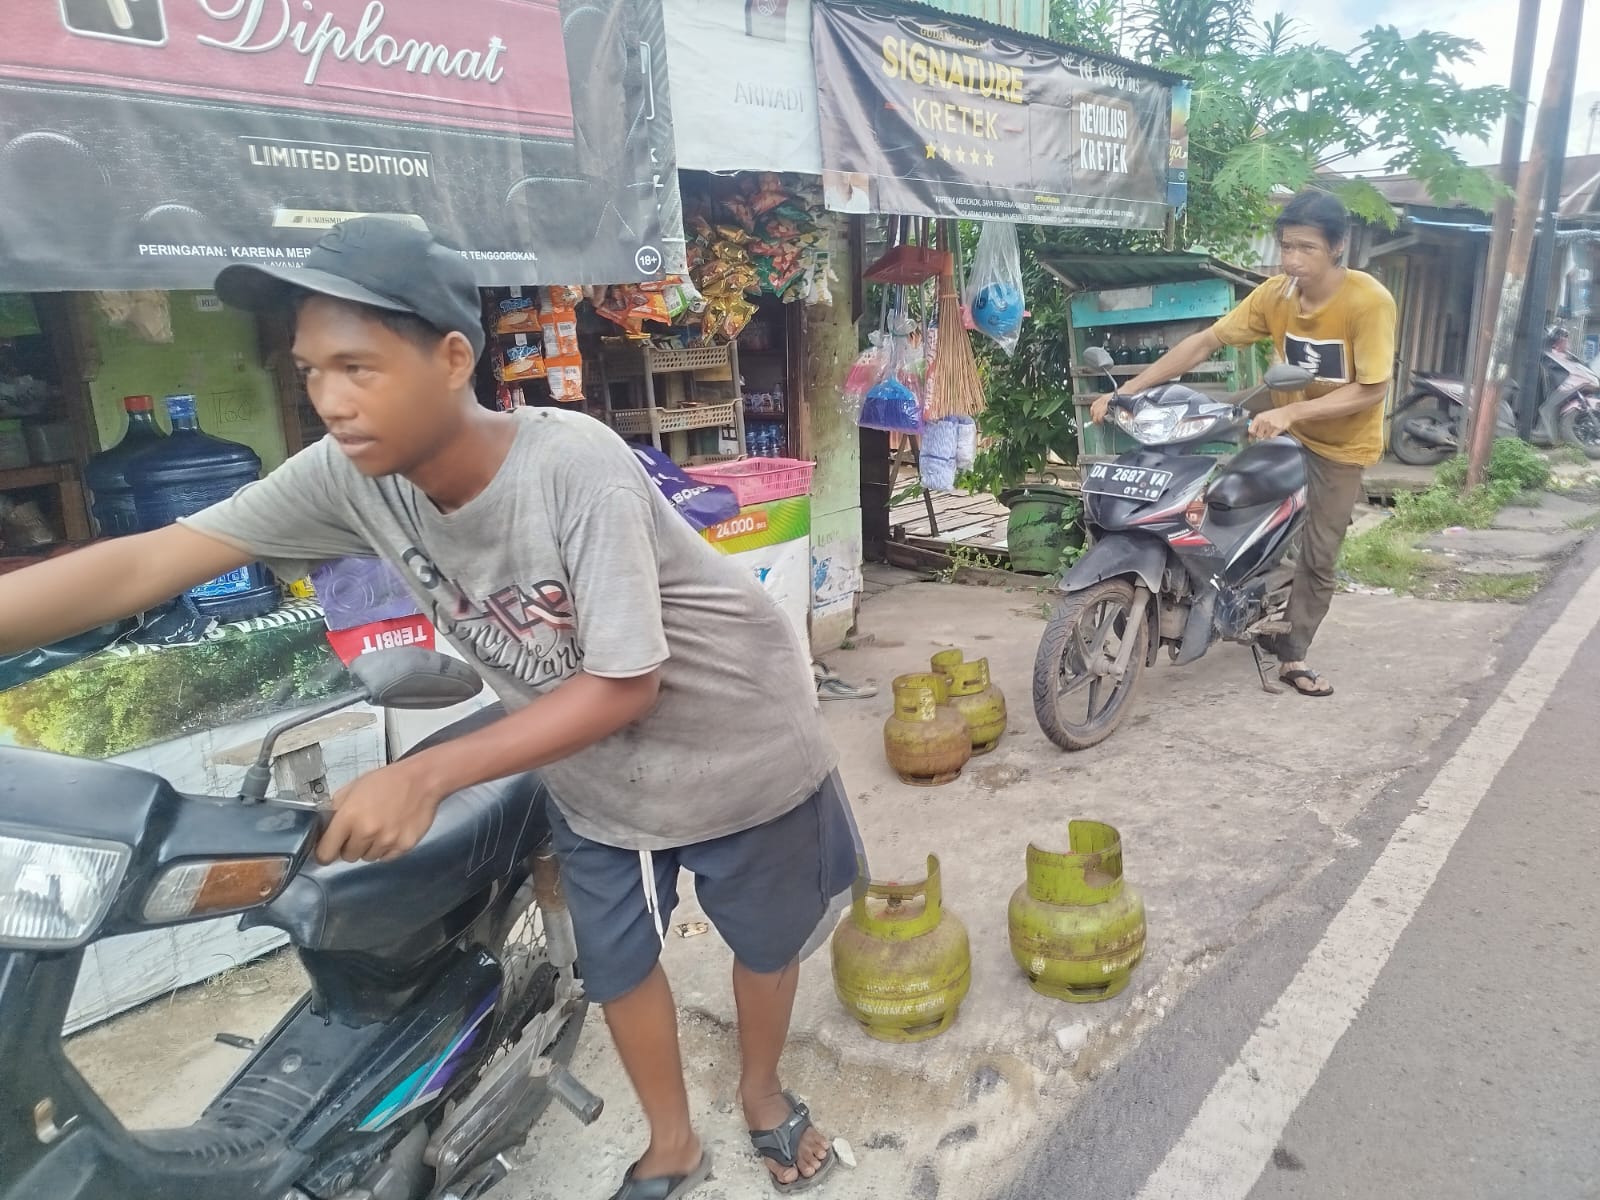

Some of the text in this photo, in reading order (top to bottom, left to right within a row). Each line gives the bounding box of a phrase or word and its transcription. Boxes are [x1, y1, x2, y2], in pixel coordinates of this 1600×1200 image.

[197, 0, 507, 85] Diplomat
[881, 35, 1024, 104] SIGNATURE
[912, 97, 998, 140] KRETEK
[1080, 101, 1128, 139] REVOLUSI
[249, 144, 429, 178] LIMITED EDITION
[1080, 138, 1128, 174] KRETEK
[139, 244, 228, 257] PERINGATAN:
[231, 246, 285, 258] KARENA
[469, 250, 538, 261] TENGGOROKAN.
[639, 255, 658, 267] 18+
[1090, 465, 1108, 479] DA
[1111, 467, 1146, 484] 2687
[716, 517, 754, 539] 24.000
[361, 624, 427, 655] TERBIT
